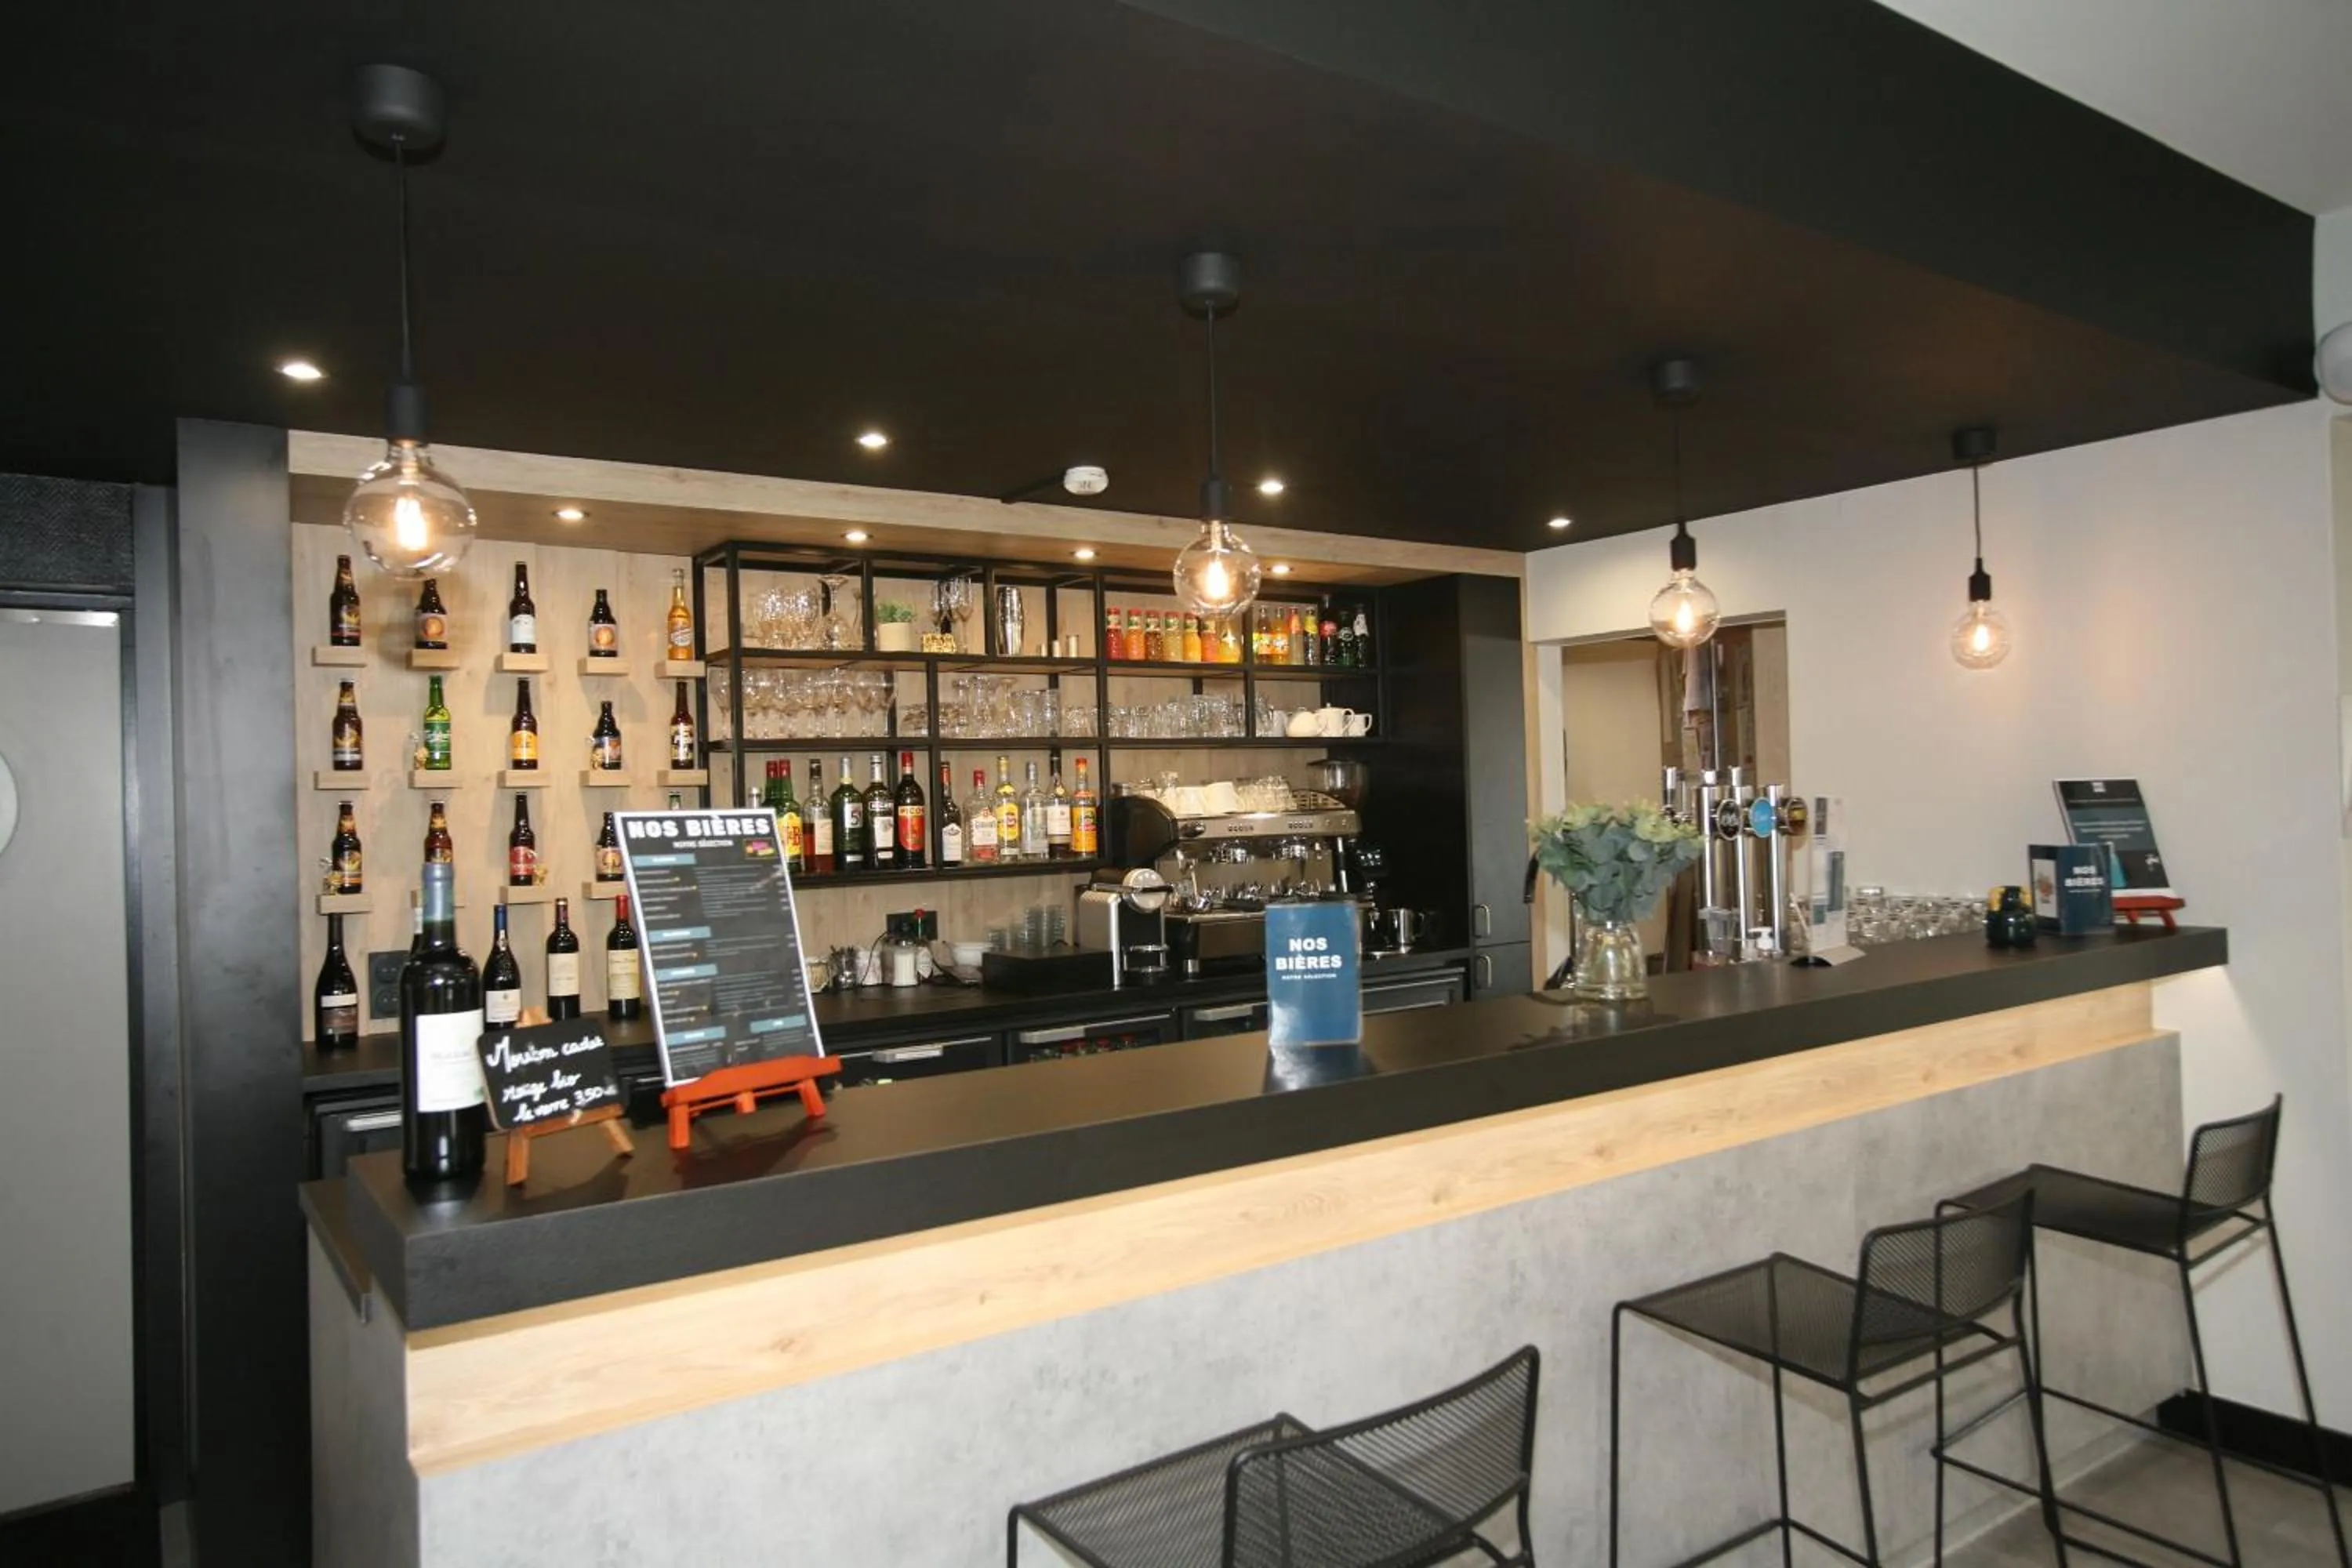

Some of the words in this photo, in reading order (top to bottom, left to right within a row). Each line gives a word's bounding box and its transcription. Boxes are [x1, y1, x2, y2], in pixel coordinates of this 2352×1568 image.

[628, 820, 679, 839] NOS
[684, 814, 771, 837] BIÈRES
[1288, 937, 1328, 952] NOS
[1275, 953, 1343, 971] BIÈRES
